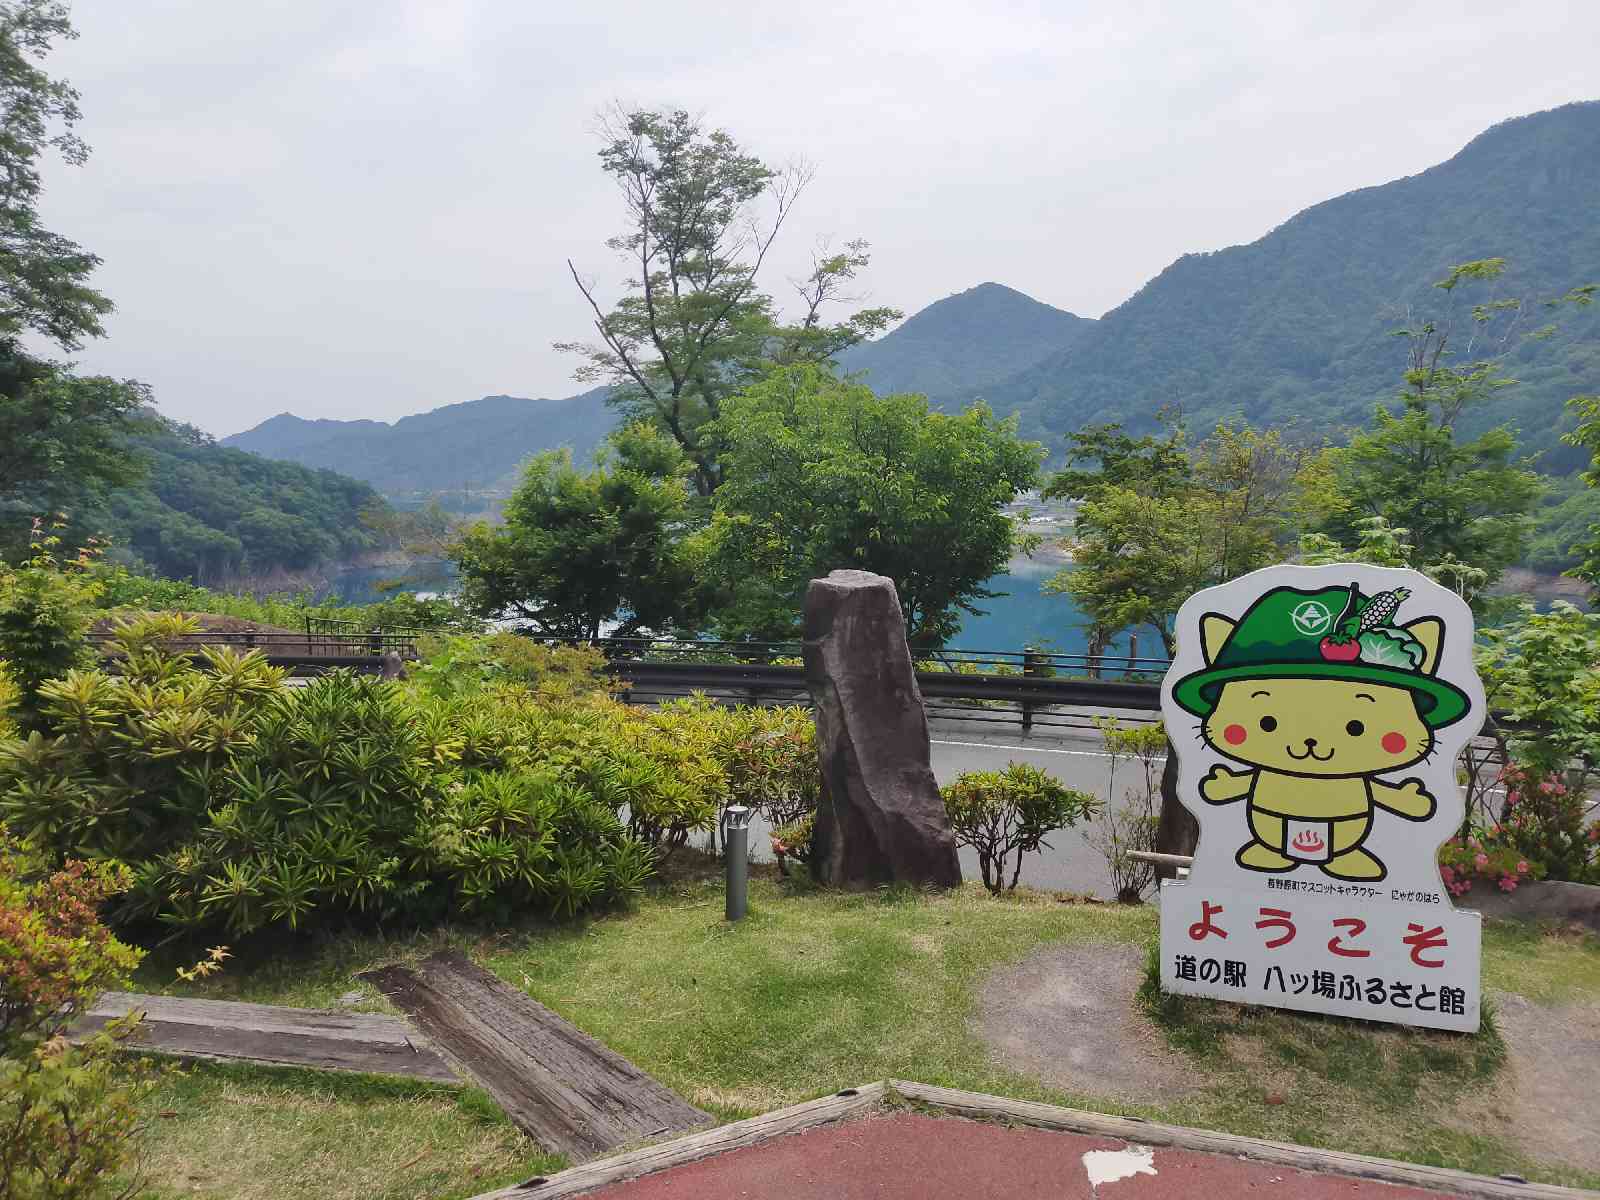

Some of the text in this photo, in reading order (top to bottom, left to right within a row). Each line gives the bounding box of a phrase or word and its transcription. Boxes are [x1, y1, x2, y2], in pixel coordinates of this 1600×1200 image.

[1391, 889, 1440, 904] にゃがのはら
[1188, 900, 1448, 968] ようこそ
[1174, 954, 1466, 1016] 道の駅 八ッ場ふるさと館
